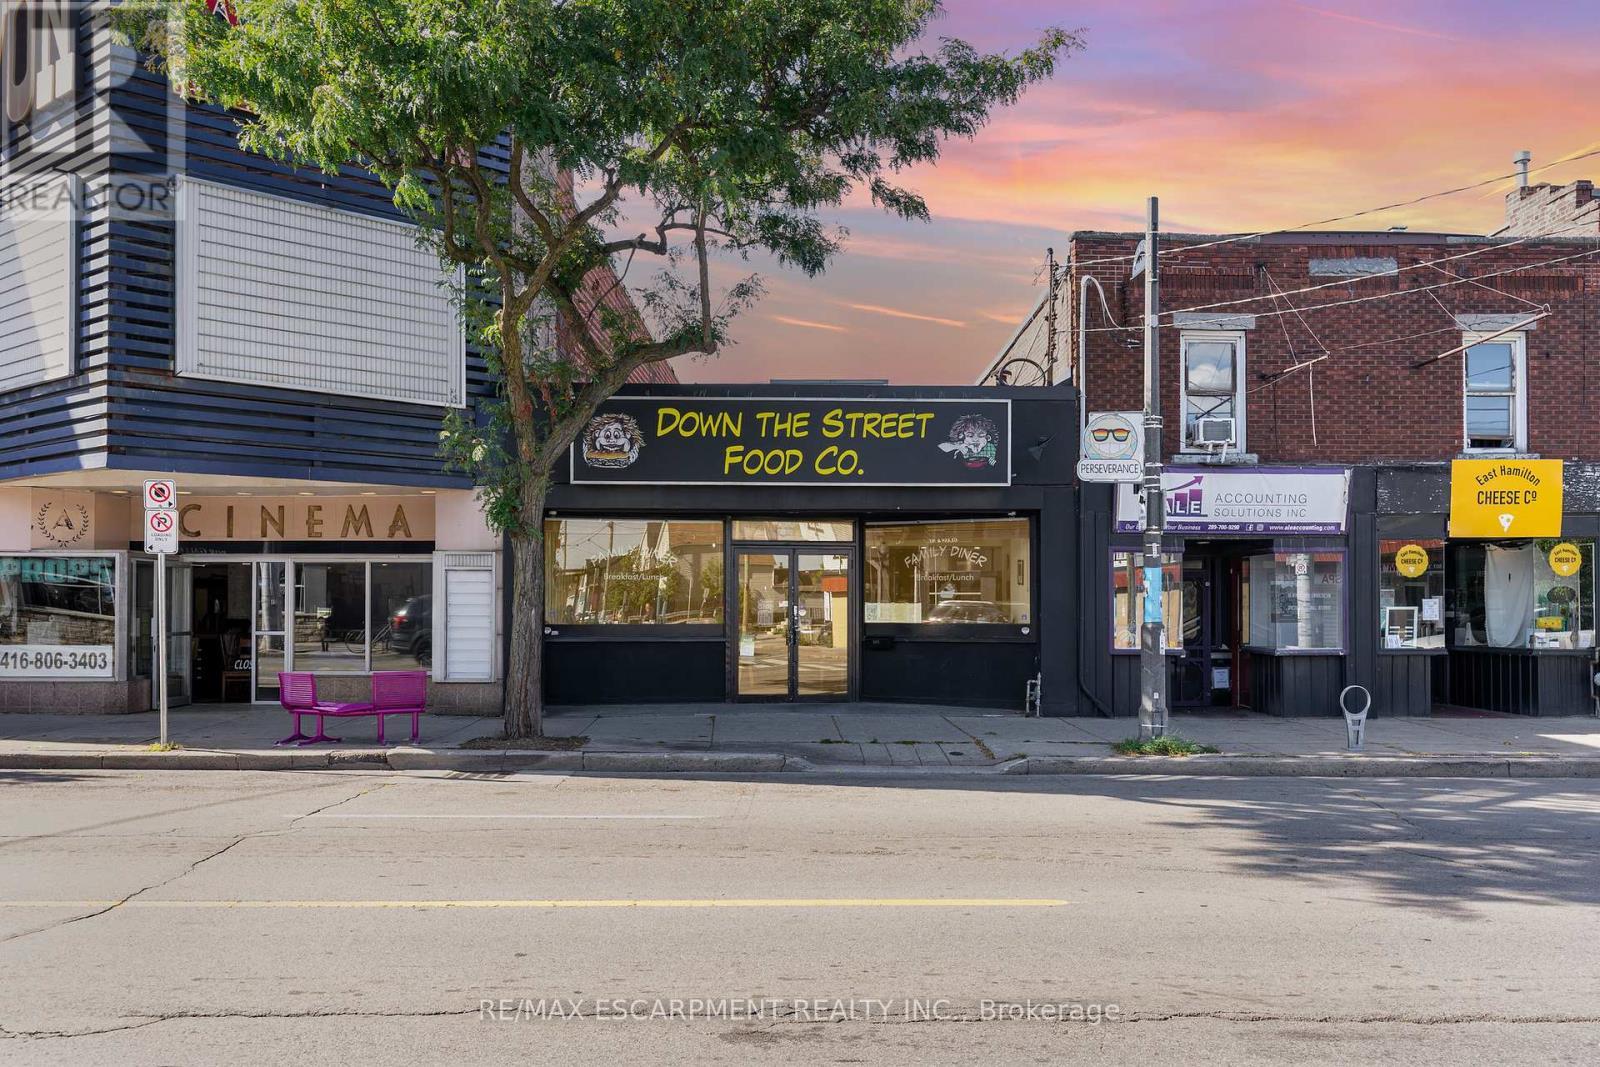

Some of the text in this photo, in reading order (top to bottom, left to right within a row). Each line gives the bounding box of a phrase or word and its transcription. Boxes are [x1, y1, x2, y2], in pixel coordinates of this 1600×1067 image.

[656, 407, 936, 438] DOWN THE STREET
[723, 445, 865, 476] FOOD CO.
[1080, 463, 1140, 474] PERSEVERANCE
[1475, 465, 1541, 487] East Hamilton
[1214, 492, 1308, 504] ACCOUNTING
[1477, 490, 1521, 505] CHEESE
[178, 503, 413, 538] CINEMA
[1213, 507, 1307, 518] SOLUTIONS INC
[904, 545, 988, 568] FAMILY DINER
[0, 651, 108, 670] 416-806-3403
